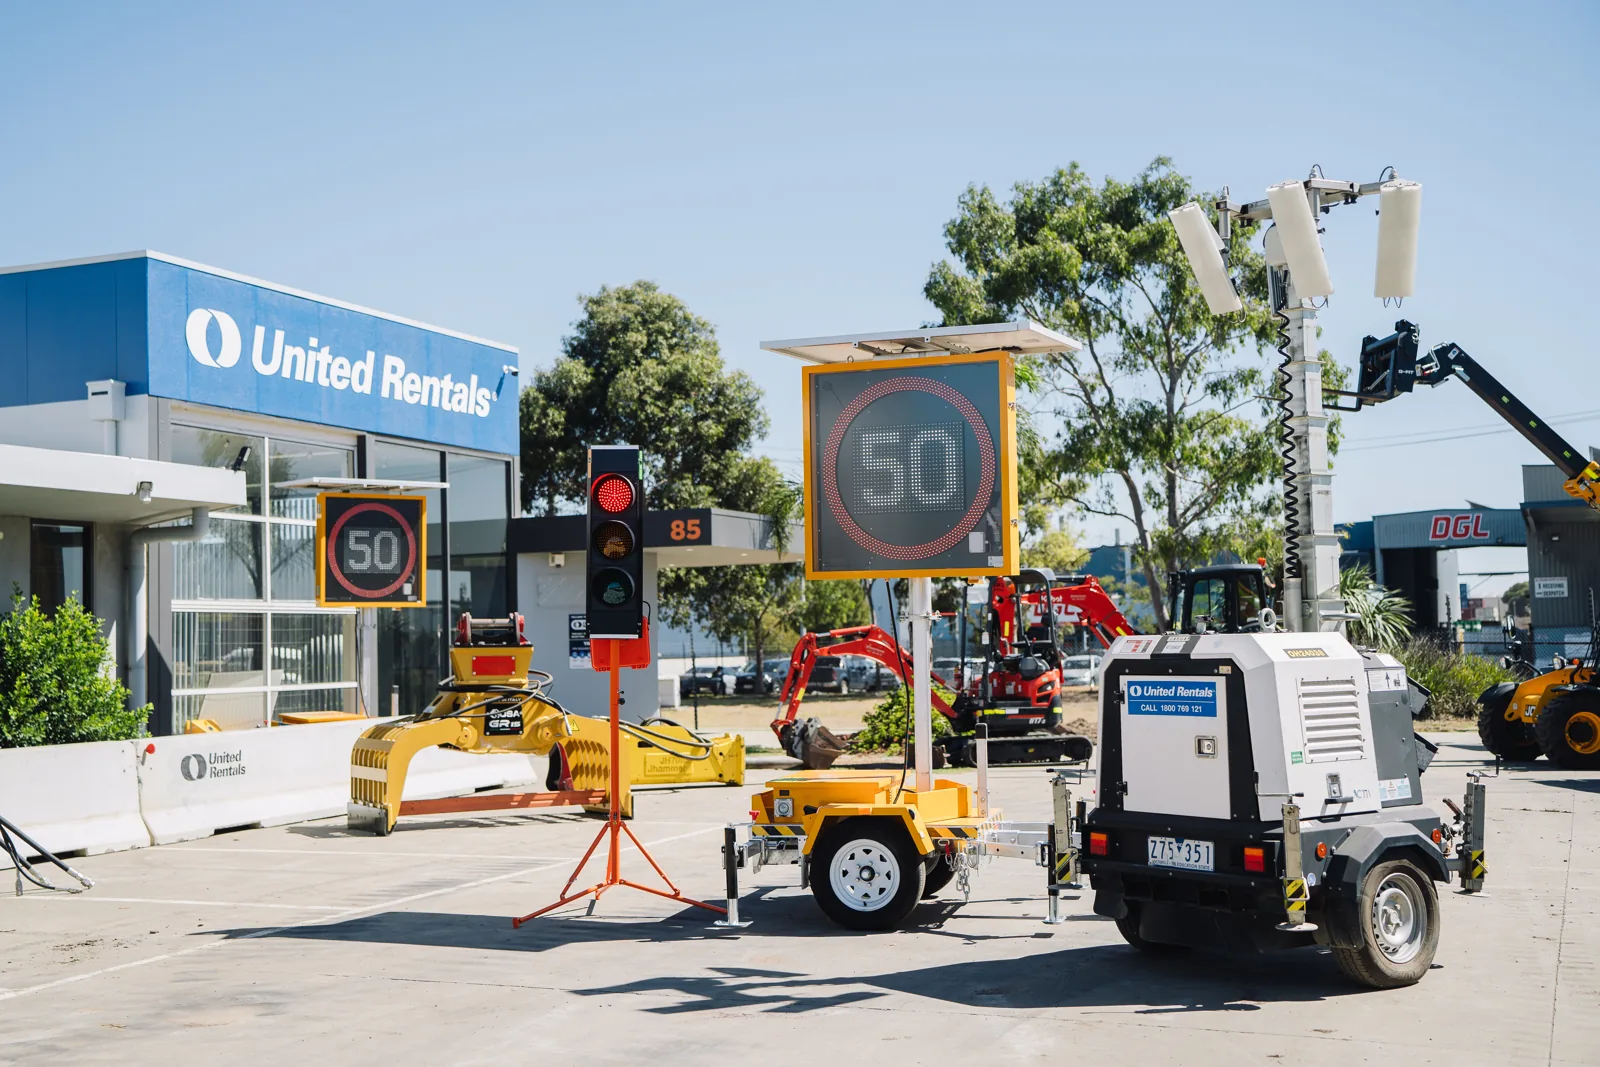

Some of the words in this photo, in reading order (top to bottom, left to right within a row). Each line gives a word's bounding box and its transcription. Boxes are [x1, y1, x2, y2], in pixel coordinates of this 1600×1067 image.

[252, 325, 375, 395] United
[381, 354, 491, 418] Rentals
[861, 428, 957, 507] 50
[670, 518, 701, 541] 85
[1429, 513, 1490, 541] DGL
[349, 530, 398, 570] 50
[1143, 685, 1176, 697] United
[1177, 686, 1213, 698] Rentals
[1140, 704, 1158, 712] CALL
[1160, 704, 1176, 712] 1800
[1191, 705, 1202, 713] 121
[208, 749, 242, 765] United
[209, 763, 246, 779] Rentals
